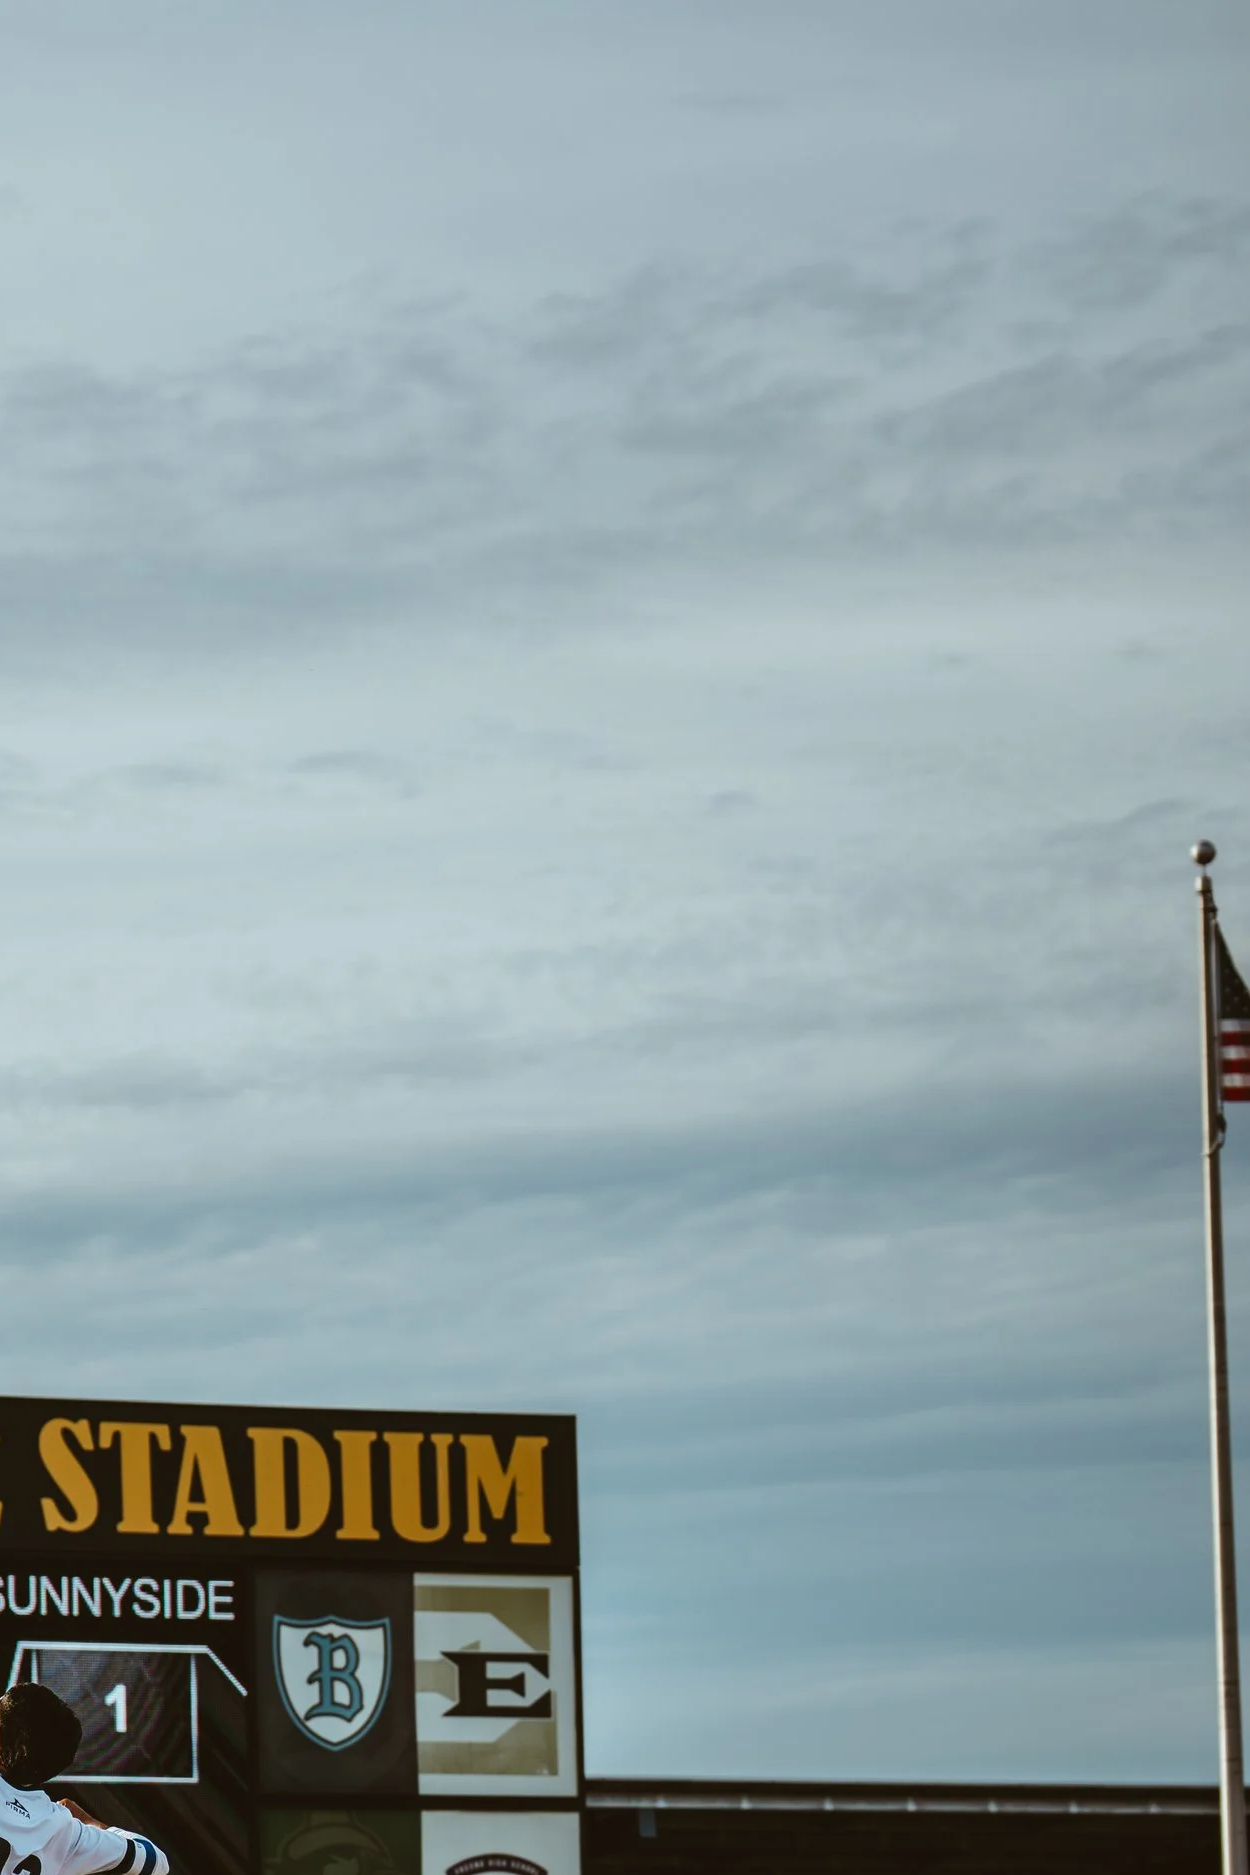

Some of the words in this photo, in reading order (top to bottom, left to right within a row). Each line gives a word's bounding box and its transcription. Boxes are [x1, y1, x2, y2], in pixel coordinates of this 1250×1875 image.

[38, 1417, 552, 1545] STADIUM
[104, 1684, 128, 1733] 1
[302, 1631, 364, 1724] B
[440, 1651, 552, 1719] E
[5, 1800, 31, 1820] PIRMA
